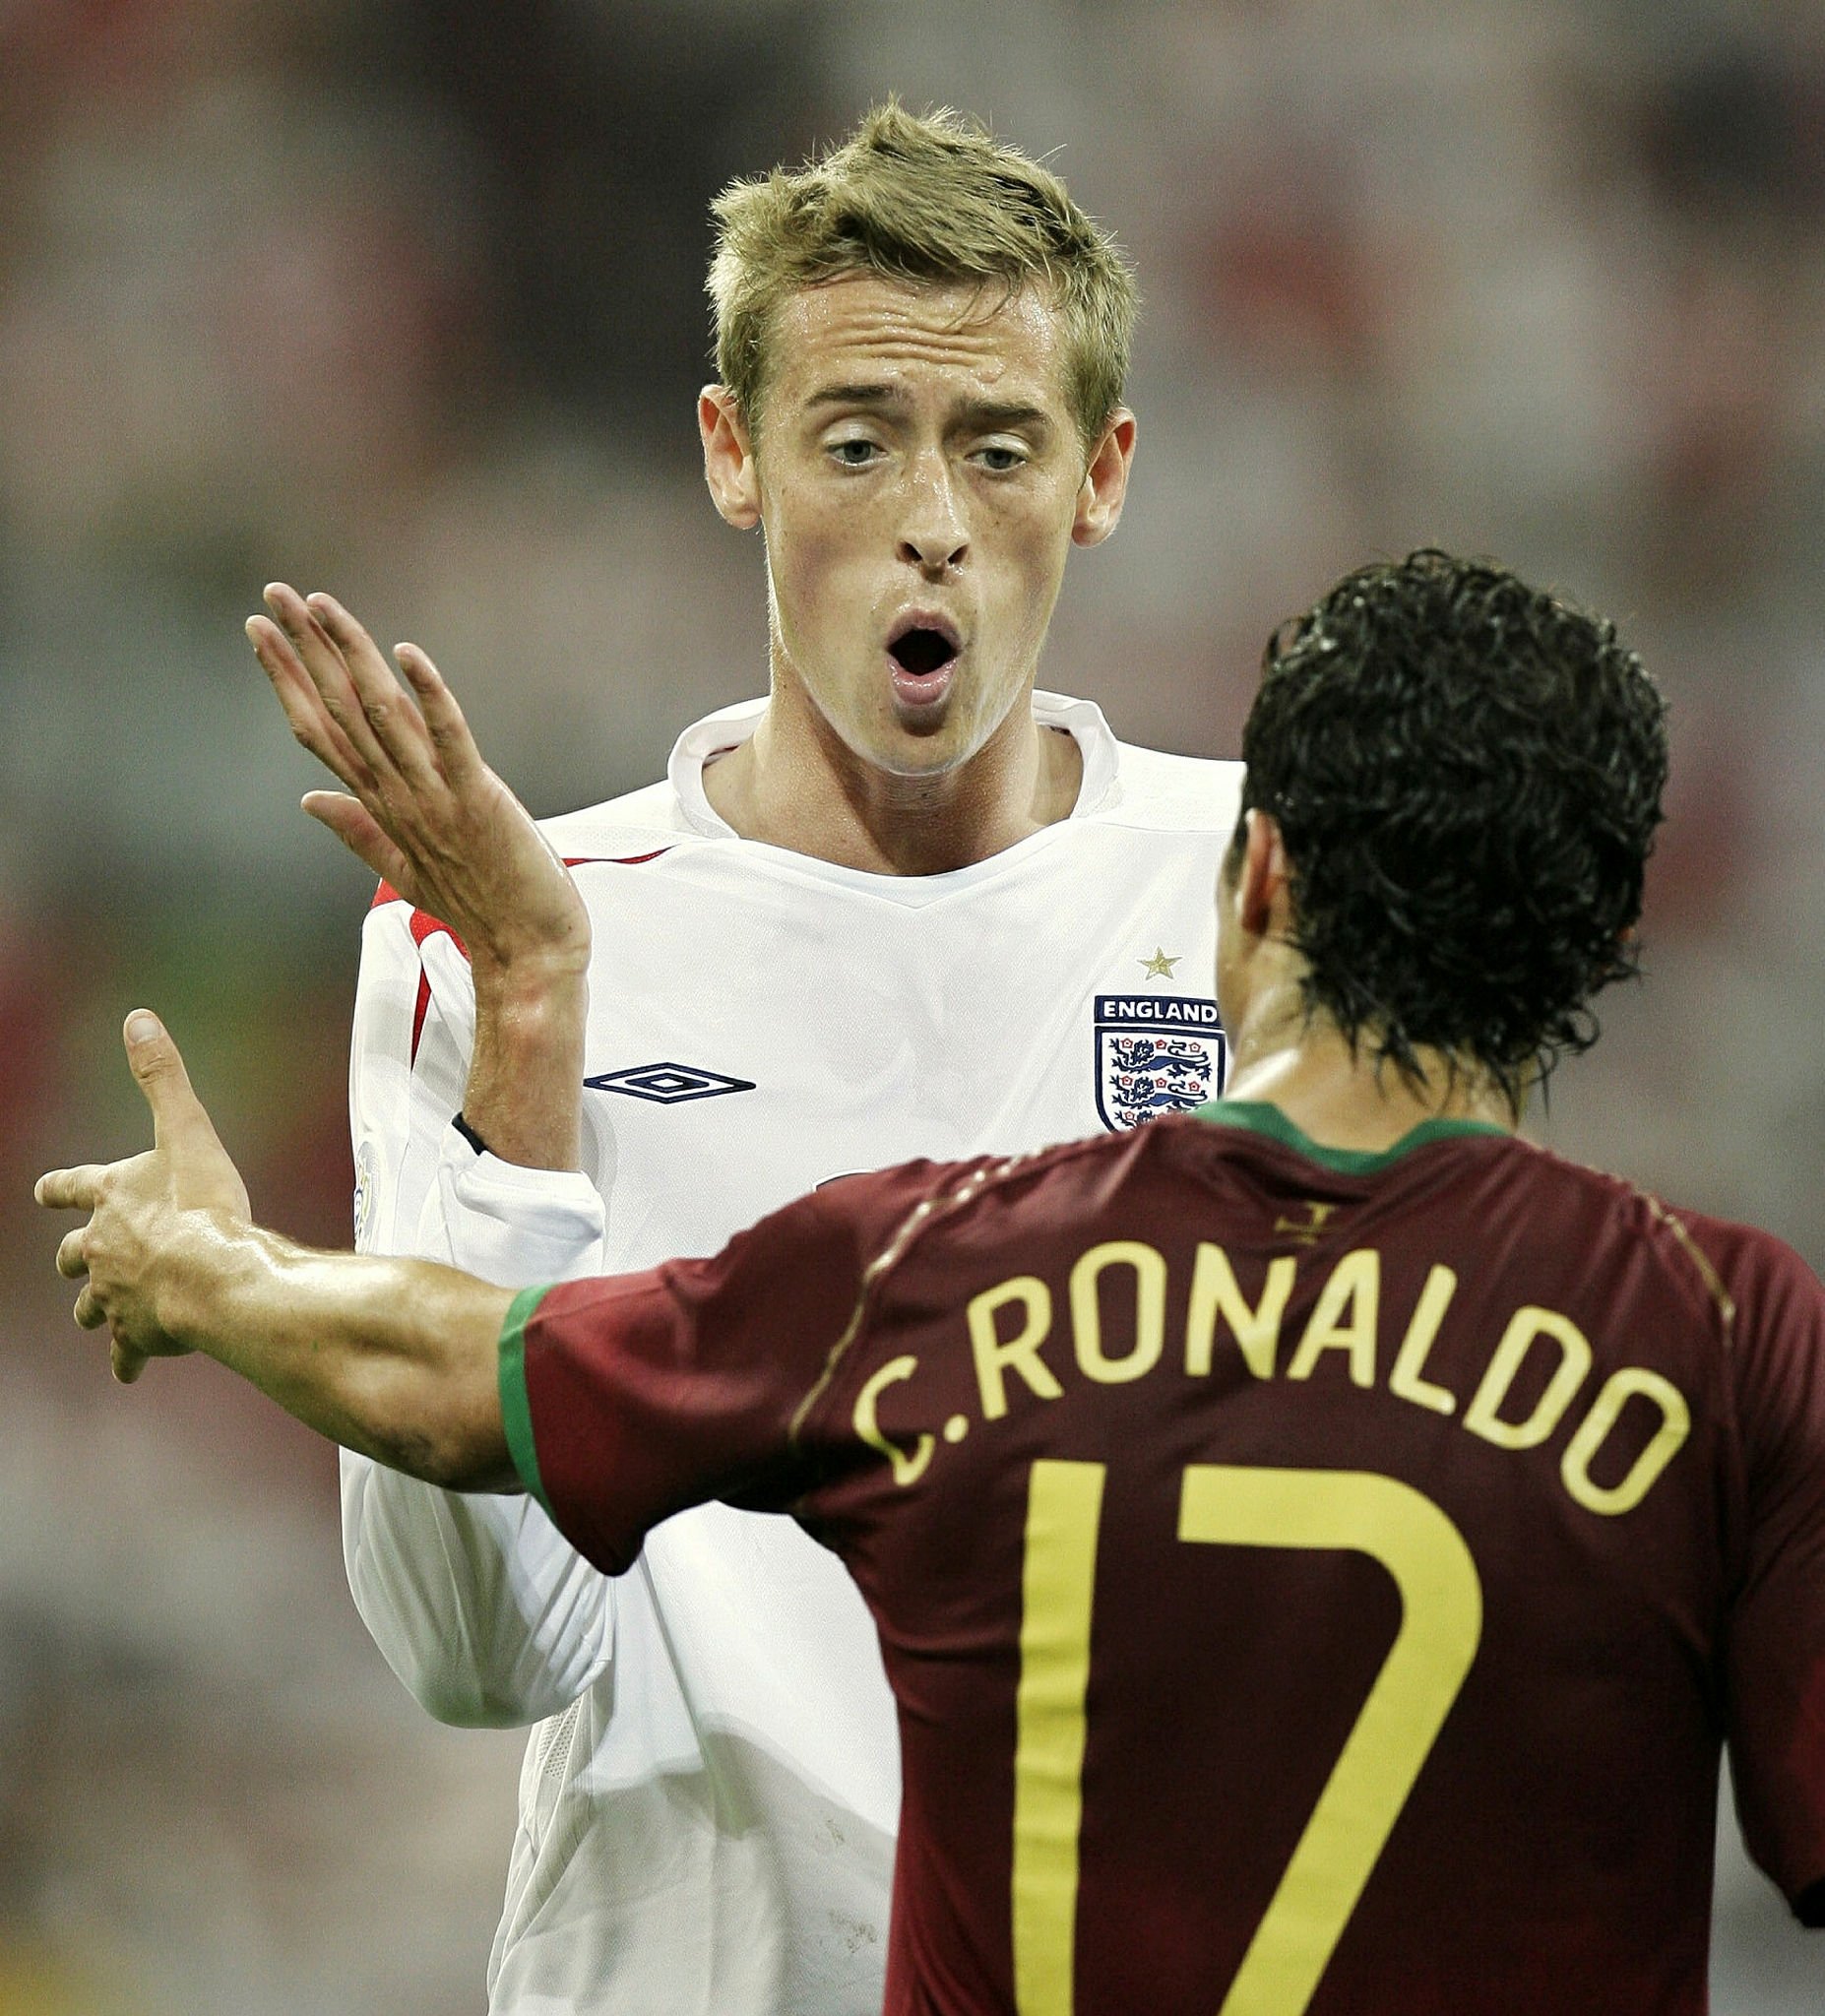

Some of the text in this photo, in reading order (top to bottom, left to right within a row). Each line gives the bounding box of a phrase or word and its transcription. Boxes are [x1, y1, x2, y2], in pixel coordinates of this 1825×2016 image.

[1102, 1000, 1218, 1023] ENGLAND
[852, 1240, 1691, 1516] C.RONALDO
[1012, 1459, 1483, 2016] 17
